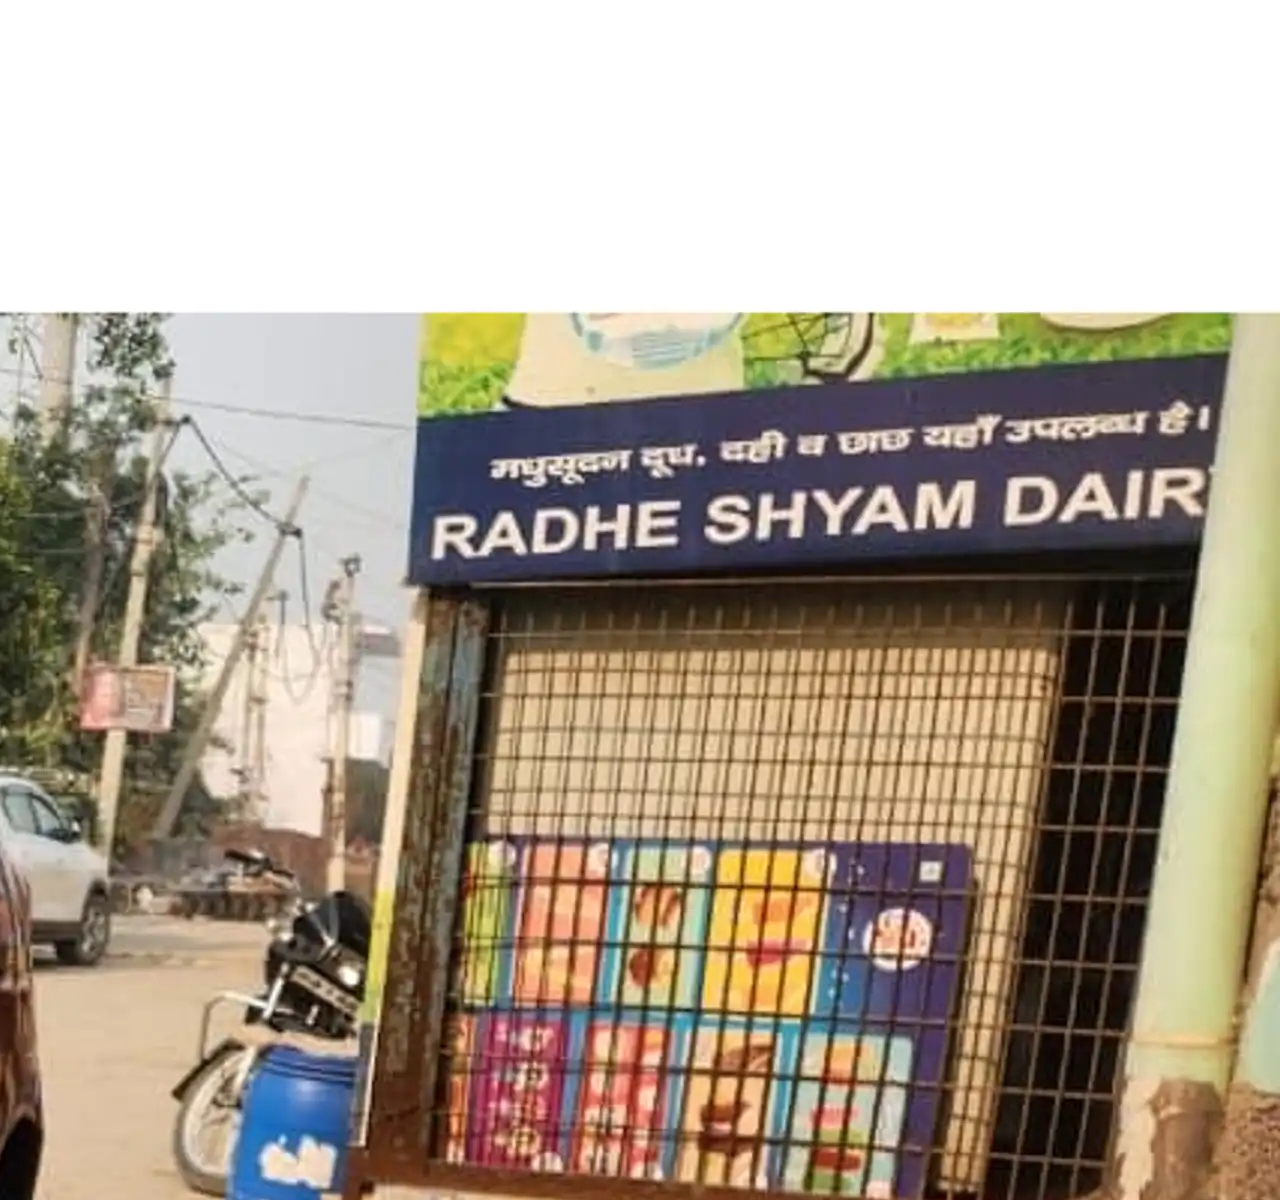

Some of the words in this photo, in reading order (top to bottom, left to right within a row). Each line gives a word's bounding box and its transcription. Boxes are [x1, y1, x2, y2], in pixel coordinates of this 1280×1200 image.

[490, 450, 632, 487] मधुसूदन
[719, 429, 788, 464] दही
[797, 433, 828, 456] व
[839, 428, 915, 455] छाछ
[1004, 410, 1149, 443] उपलब्ध
[430, 500, 682, 560] RADHE
[704, 479, 976, 544] SHYAM
[1003, 465, 1216, 526] DAIR
